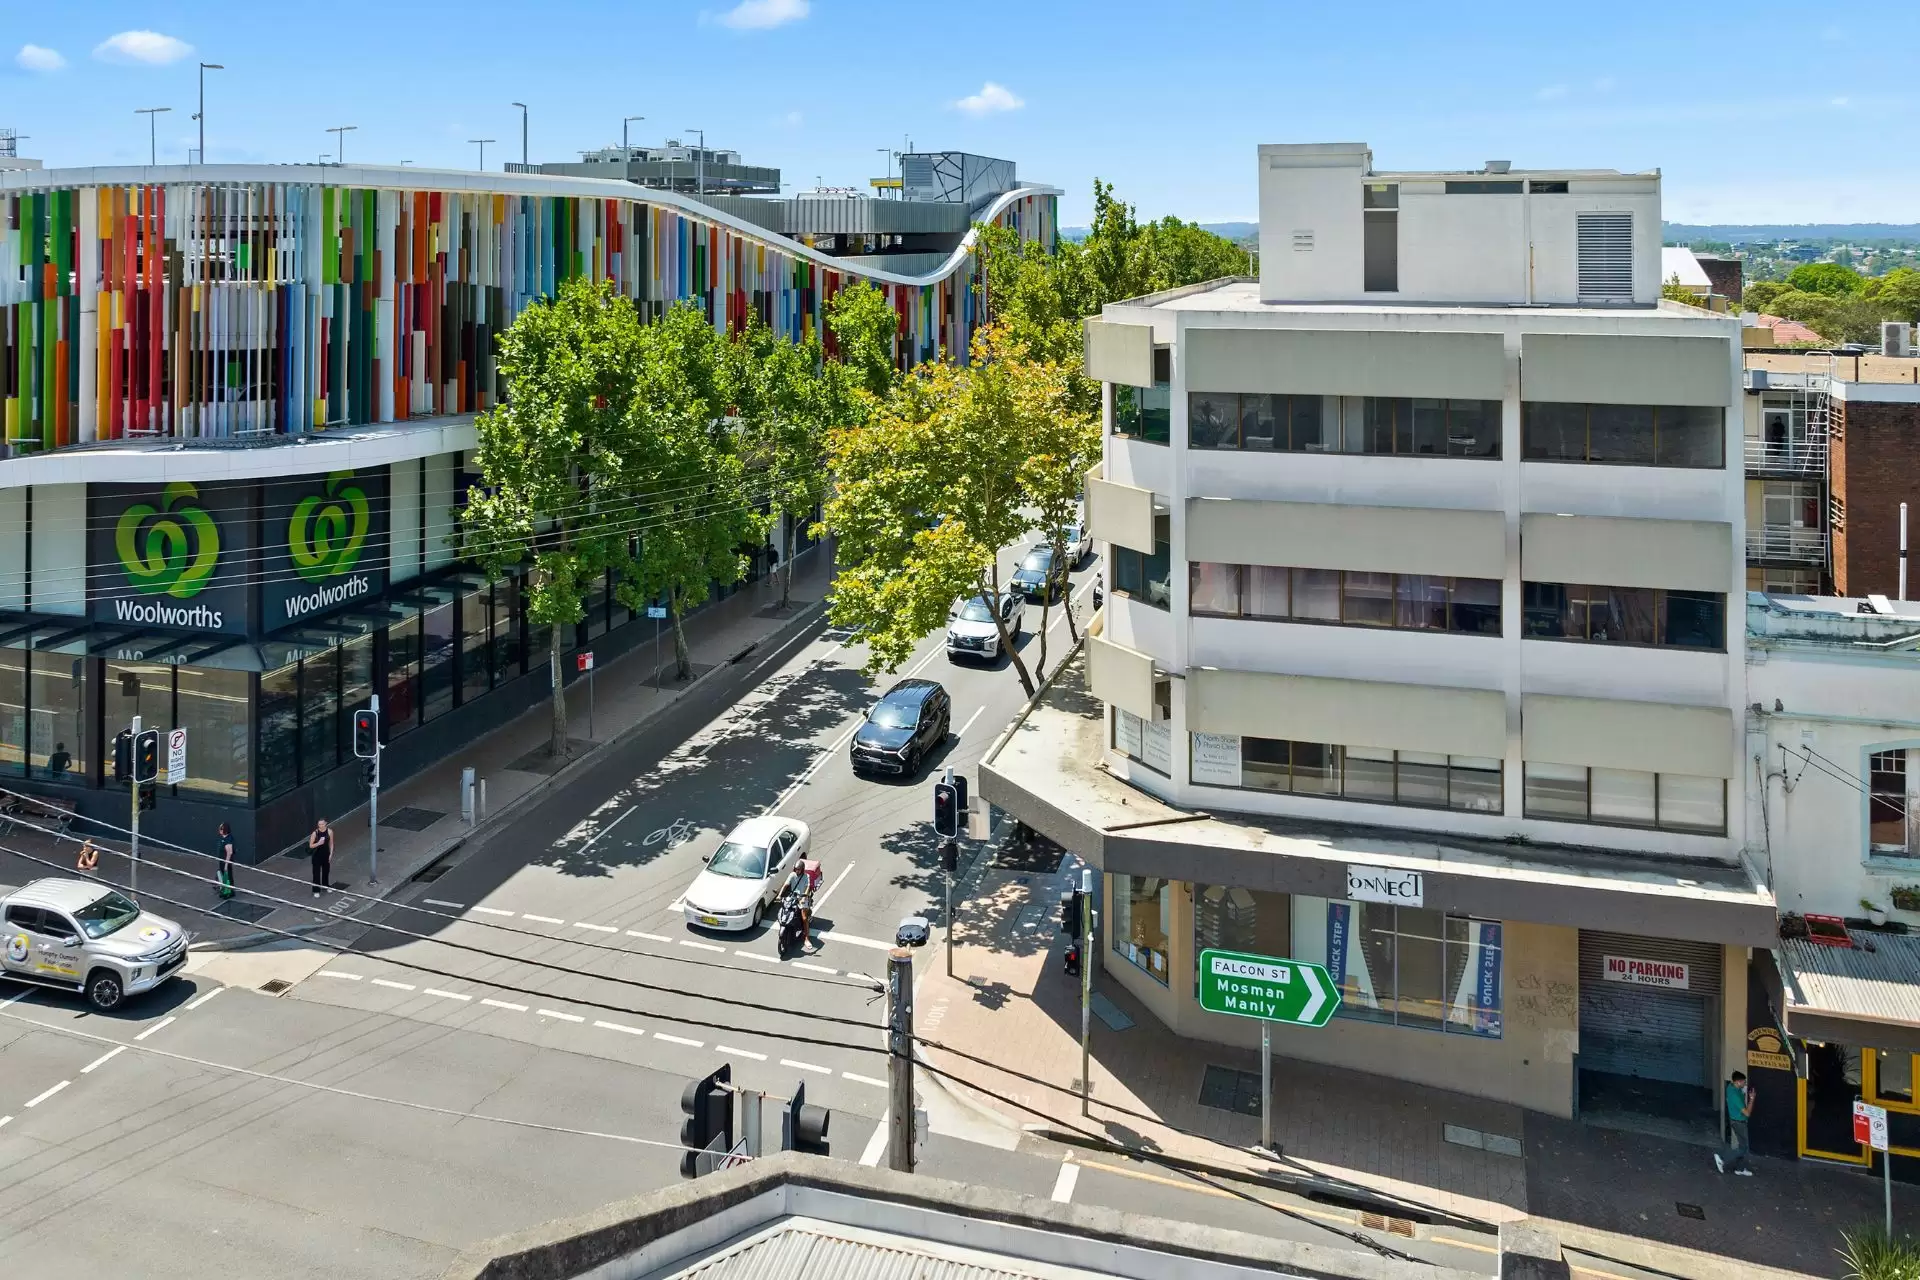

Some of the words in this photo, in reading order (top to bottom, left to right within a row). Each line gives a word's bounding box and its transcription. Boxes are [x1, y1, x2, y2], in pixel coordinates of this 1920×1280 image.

[285, 574, 369, 618] Woolworths
[115, 599, 223, 629] Woolworths
[172, 749, 183, 757] NO
[171, 762, 184, 770] TURN
[1347, 872, 1421, 898] ONNECT
[1333, 921, 1343, 946] STEP
[1215, 961, 1265, 977] FALCON
[1271, 969, 1287, 980] ST
[1331, 948, 1341, 981] QUICK
[1608, 958, 1626, 973] NO
[1628, 961, 1684, 980] PARKING
[1217, 978, 1285, 999] Mosman
[1622, 973, 1633, 981] 24
[1637, 975, 1670, 985] HOURS
[1225, 995, 1276, 1016] Manly
